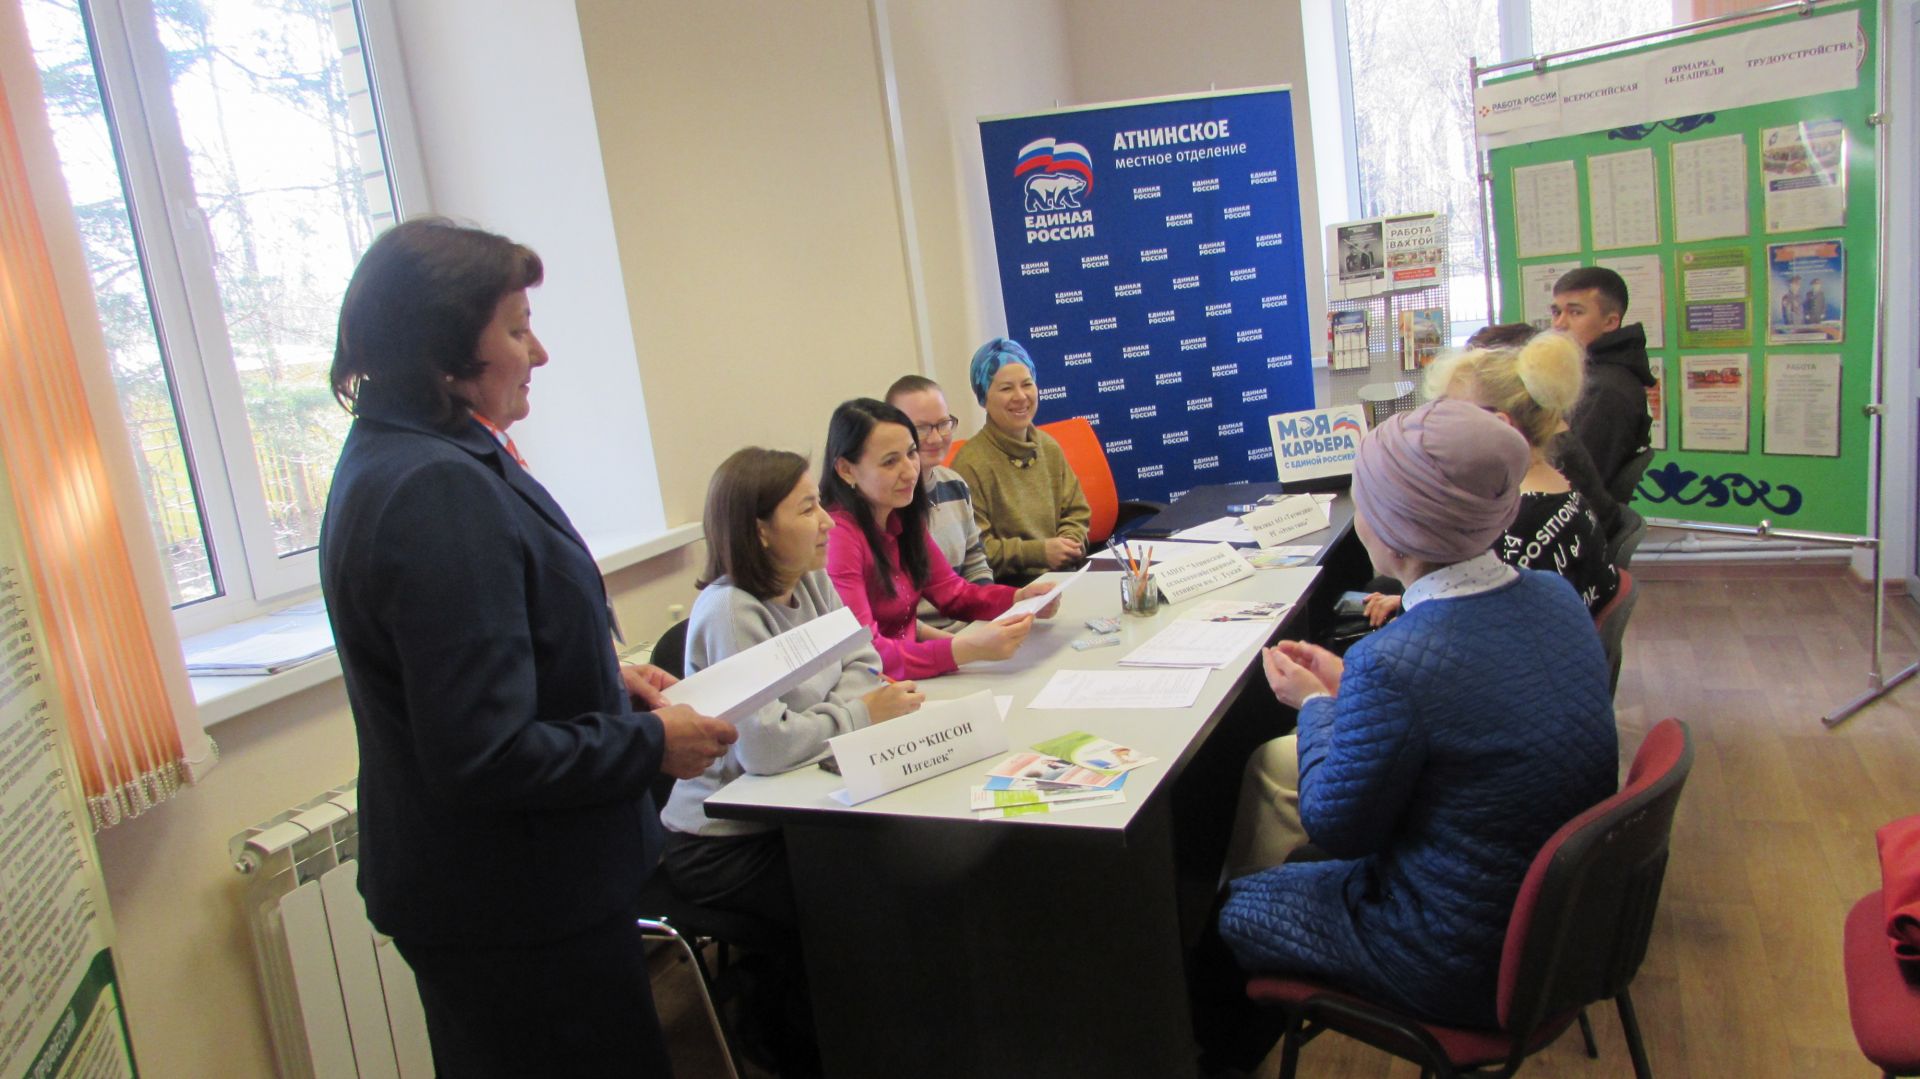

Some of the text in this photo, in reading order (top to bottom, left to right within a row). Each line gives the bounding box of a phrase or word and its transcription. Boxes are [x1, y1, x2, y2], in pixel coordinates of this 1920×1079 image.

[1746, 42, 1853, 67] ТРУДОУСТРОЙСТВА
[1671, 59, 1716, 74] ЯРМАРКА
[1687, 67, 1724, 81] АПРЕЛЯ
[1563, 82, 1638, 103] ВСЕРОССИЙСКАЯ
[1492, 98, 1522, 110] РАБОТА
[1524, 91, 1557, 104] РОССИИ
[1113, 119, 1230, 151] АТНИНСКОЕ
[1115, 142, 1247, 169] местное отделение
[1250, 170, 1276, 179] ЕДИНАЯ
[1192, 178, 1219, 187] ЕДИНАЯ
[1251, 176, 1277, 185] РОССИЯ
[1133, 185, 1160, 194] ЕДИНАЯ
[1193, 184, 1220, 193] РОССИЯ
[1134, 191, 1161, 200] РОССИЯ
[1224, 204, 1250, 213] ЕДИНАЯ
[1025, 209, 1093, 229] ЕДИНАЯ
[1166, 213, 1192, 222] ЕДИНАЯ
[1225, 211, 1251, 220] РОССИЯ
[1167, 219, 1193, 228] РОССИЯ
[1027, 224, 1095, 244] РОССИЯ
[1390, 226, 1431, 237] РАБОТА
[1256, 233, 1281, 242] ЕДИНАЯ
[1199, 240, 1225, 249] ЕДИНАЯ
[1257, 239, 1282, 248] РОССИЯ
[1140, 248, 1167, 257] ЕДИНАЯ
[1200, 247, 1226, 256] РОССИЯ
[1081, 254, 1108, 263] ЕДИНАЯ
[1141, 254, 1168, 263] РОССИЯ
[1021, 261, 1048, 270] ЕДИНАЯ
[1082, 260, 1109, 269] РОССИЯ
[1022, 267, 1049, 276] РОССИЯ
[1230, 267, 1255, 276] ЕДИНАЯ
[1172, 275, 1199, 284] ЕДИНАЯ
[1231, 273, 1256, 282] РОССИЯ
[1114, 283, 1141, 292] ЕДИНАЯ
[1173, 281, 1200, 290] РОССИЯ
[1055, 290, 1082, 299] ЕДИНАЯ
[1115, 289, 1142, 298] РОССИЯ
[1056, 296, 1083, 305] РОССИЯ
[1262, 294, 1287, 303] ЕДИНАЯ
[1205, 302, 1231, 311] ЕДИНАЯ
[1263, 300, 1288, 309] РОССИЯ
[1148, 310, 1174, 319] ЕДИНАЯ
[1206, 308, 1232, 317] РОССИЯ
[1090, 317, 1116, 326] ЕДИНАЯ
[1149, 316, 1175, 325] РОССИЯ
[1030, 324, 1057, 333] ЕДИНАЯ
[1091, 323, 1117, 332] РОССИЯ
[1031, 330, 1058, 339] РОССИЯ
[1237, 328, 1262, 337] ЕДИНАЯ
[1180, 336, 1206, 345] ЕДИНАЯ
[1238, 334, 1263, 343] РОССИЯ
[1122, 344, 1149, 353] ЕДИНАЯ
[1181, 342, 1207, 351] РОССИЯ
[1064, 352, 1091, 361] ЕДИНАЯ
[1123, 350, 1150, 359] РОССИЯ
[1267, 354, 1291, 363] ЕДИНАЯ
[1065, 358, 1092, 367] РОССИЯ
[1268, 360, 1292, 369] РОССИЯ
[1212, 363, 1237, 372] ЕДИНАЯ
[1155, 371, 1181, 380] ЕДИНАЯ
[1213, 369, 1238, 378] РОССИЯ
[1098, 378, 1124, 387] ЕДИНАЯ
[1156, 377, 1182, 386] РОССИЯ
[1038, 386, 1066, 395] ЕДИНАЯ
[1099, 384, 1125, 393] РОССИЯ
[1242, 388, 1267, 397] ЕДИНАЯ
[1039, 392, 1067, 401] РОССИЯ
[1243, 394, 1268, 403] РОССИЯ
[1187, 397, 1212, 406] ЕДИНАЯ
[1130, 405, 1156, 414] ЕДИНАЯ
[1188, 403, 1213, 412] РОССИЯ
[1131, 411, 1157, 420] РОССИЯ
[1218, 422, 1243, 431] ЕДИНАЯ
[1277, 414, 1331, 441] МОЯ
[1162, 430, 1188, 439] ЕДИНАЯ
[1219, 428, 1244, 437] РОССИЯ
[1106, 439, 1131, 448] ЕДИНАЯ
[1163, 436, 1189, 445] РОССИЯ
[1107, 445, 1132, 454] РОССИЯ
[1281, 434, 1355, 458] КАРЬЕРА
[1193, 455, 1218, 464] ЕДИНАЯ
[1291, 456, 1322, 469] ЕДИНОЙ
[1137, 464, 1163, 473] ЕДИНАЯ
[1194, 461, 1219, 470] РОССИЯ
[1138, 470, 1164, 479] РОССИЯ
[1169, 490, 1190, 499] ЕДИН
[869, 741, 917, 766] ГАУСО
